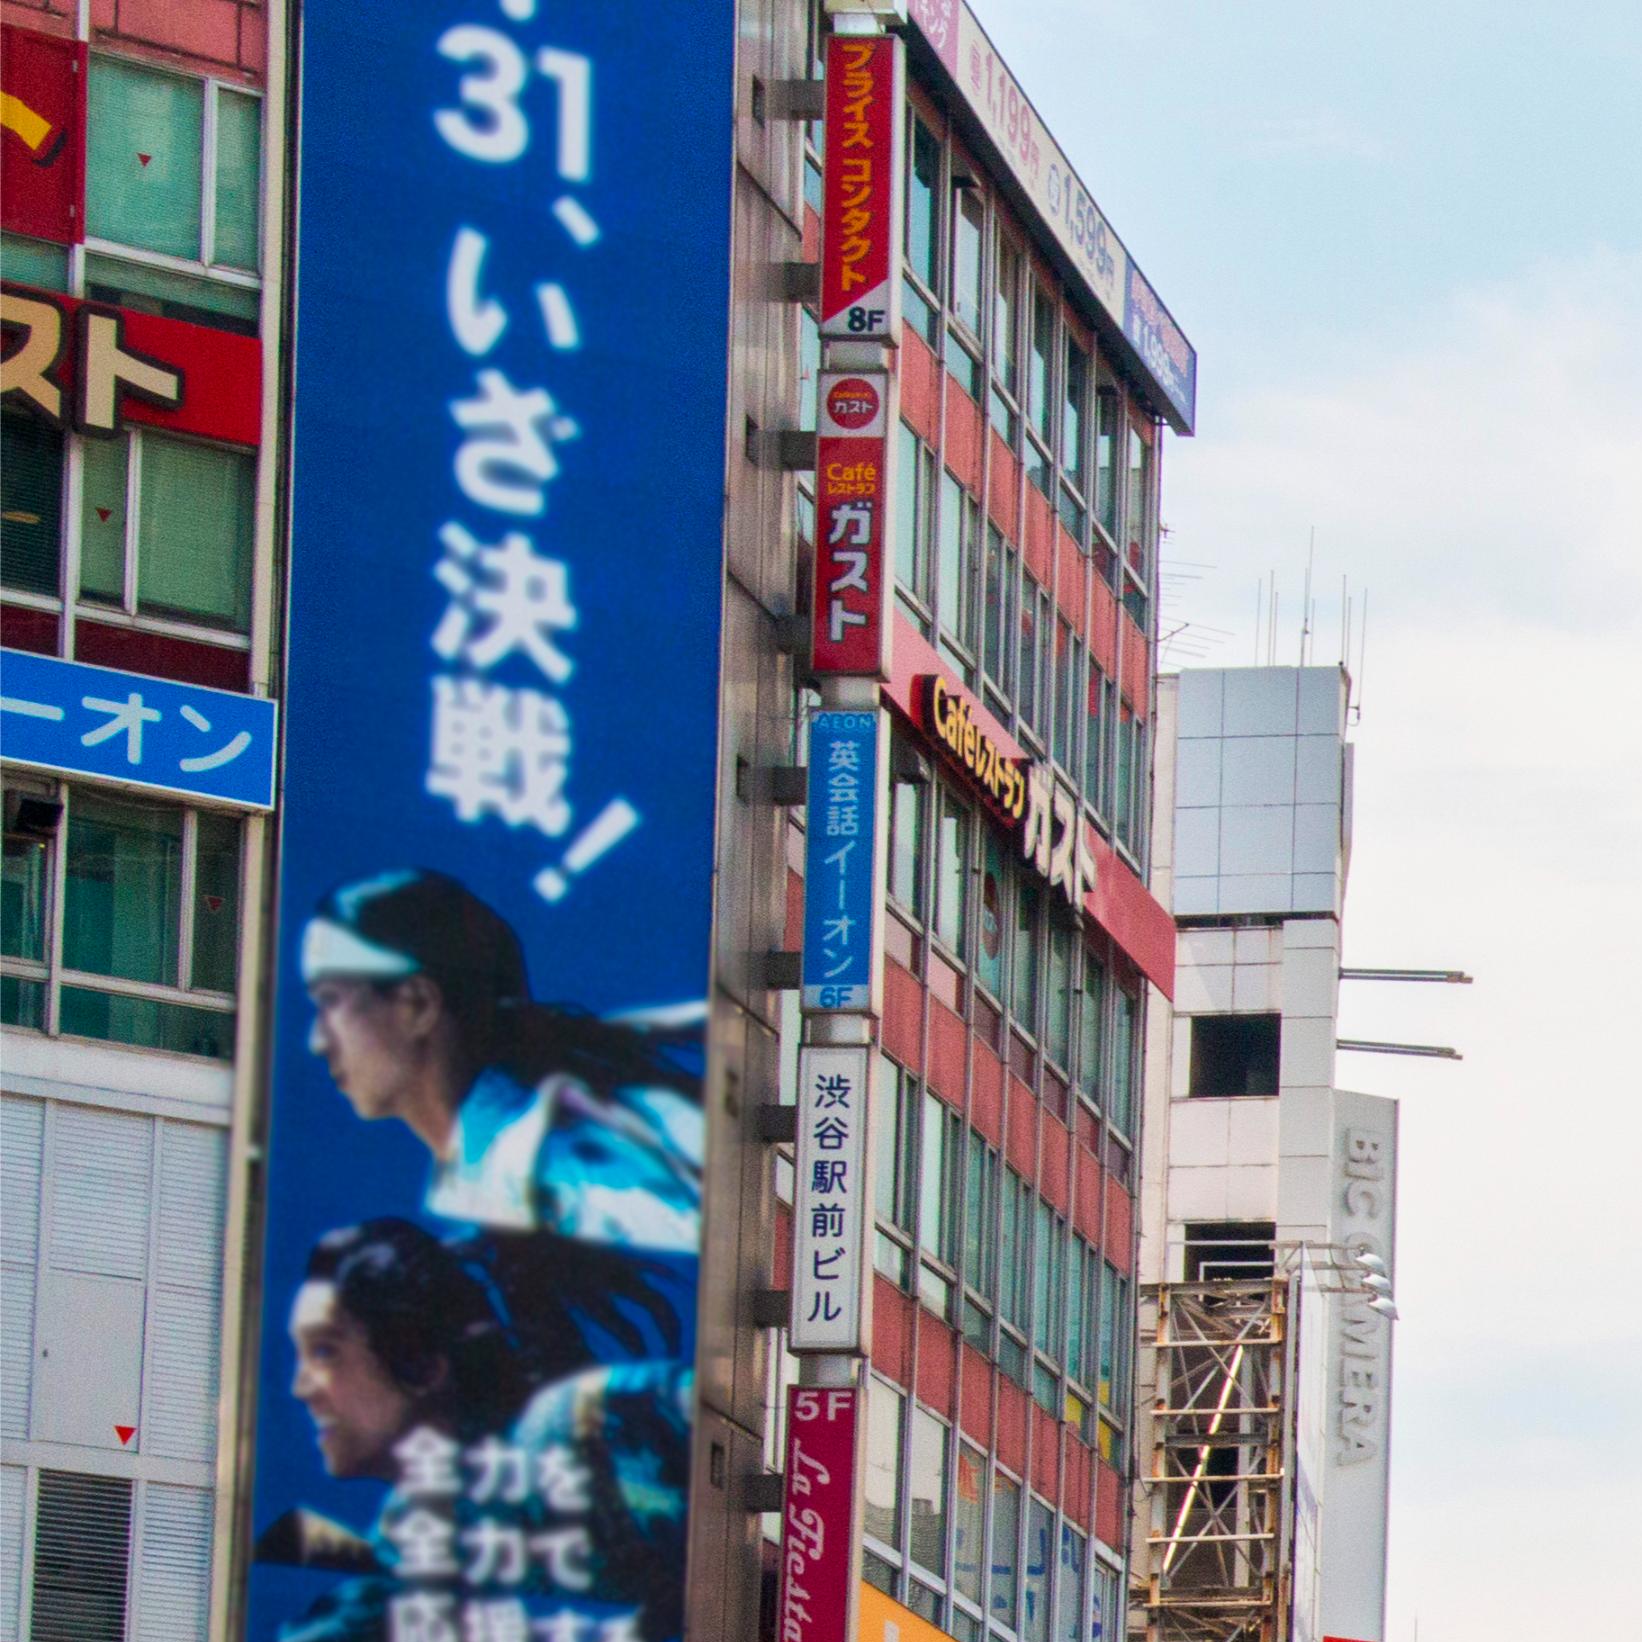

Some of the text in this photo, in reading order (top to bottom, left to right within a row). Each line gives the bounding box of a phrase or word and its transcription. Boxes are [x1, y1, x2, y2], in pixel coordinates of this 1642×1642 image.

[839, 44, 875, 294] プライス コンタクト
[848, 306, 886, 333] 8F
[833, 402, 874, 414] ガスト
[827, 463, 877, 482] Café
[827, 482, 876, 495] レストラン
[829, 501, 874, 643] ガスト
[818, 712, 872, 730] AEON
[822, 741, 861, 979] 英会話 イーオン
[1023, 755, 1098, 910] ガスト
[818, 986, 853, 1009] 6F
[806, 1072, 852, 1323] 渋谷駅前ビル
[1343, 1127, 1383, 1219] BIC
[794, 1391, 853, 1422] 5F
[395, 1426, 593, 1511] 全力を
[791, 1438, 831, 1496] La
[391, 1510, 593, 1591] 全力で
